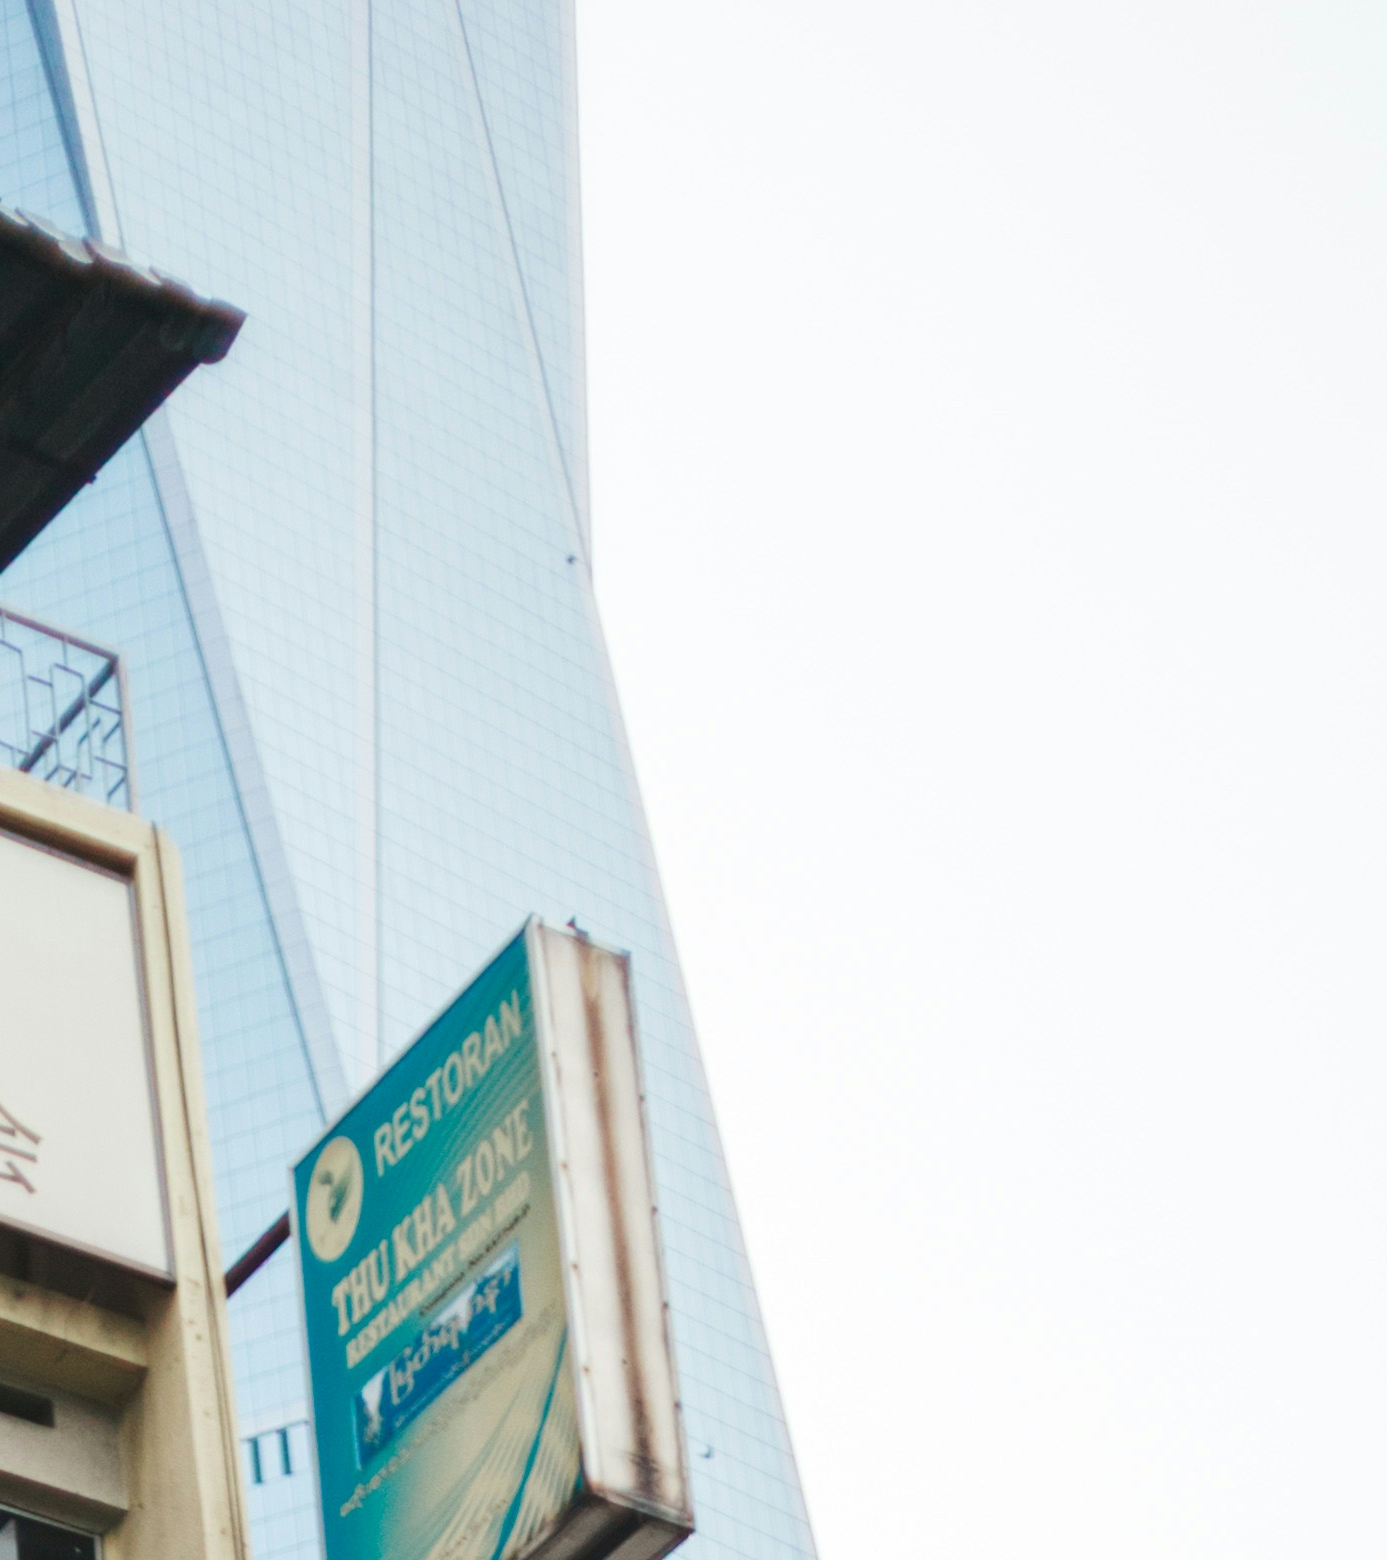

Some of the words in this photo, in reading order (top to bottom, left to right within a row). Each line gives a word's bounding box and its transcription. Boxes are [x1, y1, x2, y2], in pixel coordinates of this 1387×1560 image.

[374, 989, 523, 1177] RESTORAN
[331, 1239, 389, 1337] THU
[392, 1183, 456, 1286] KHA
[456, 1099, 534, 1217] ZONE
[346, 1244, 455, 1369] RESTAURANT
